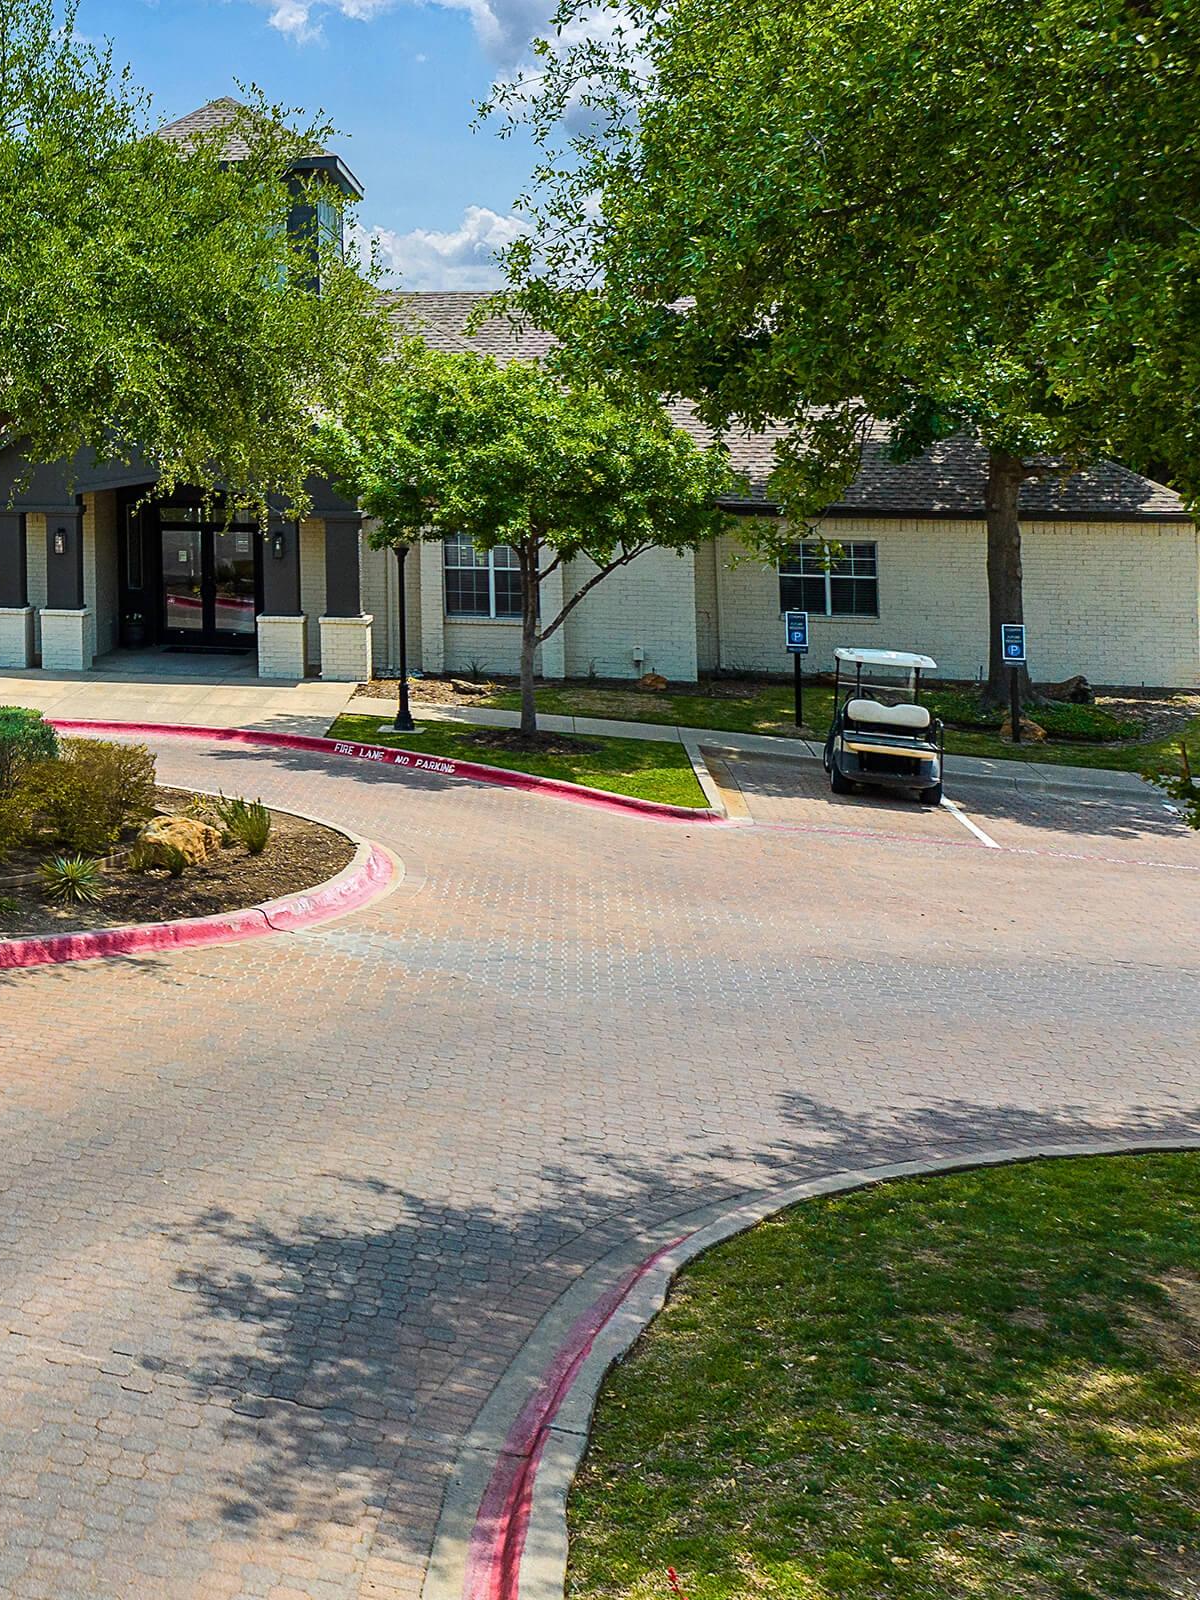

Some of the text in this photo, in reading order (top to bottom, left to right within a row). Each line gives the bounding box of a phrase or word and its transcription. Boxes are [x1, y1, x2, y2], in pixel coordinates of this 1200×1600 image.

[334, 743, 456, 773] FIRE LANE NO PARKING
